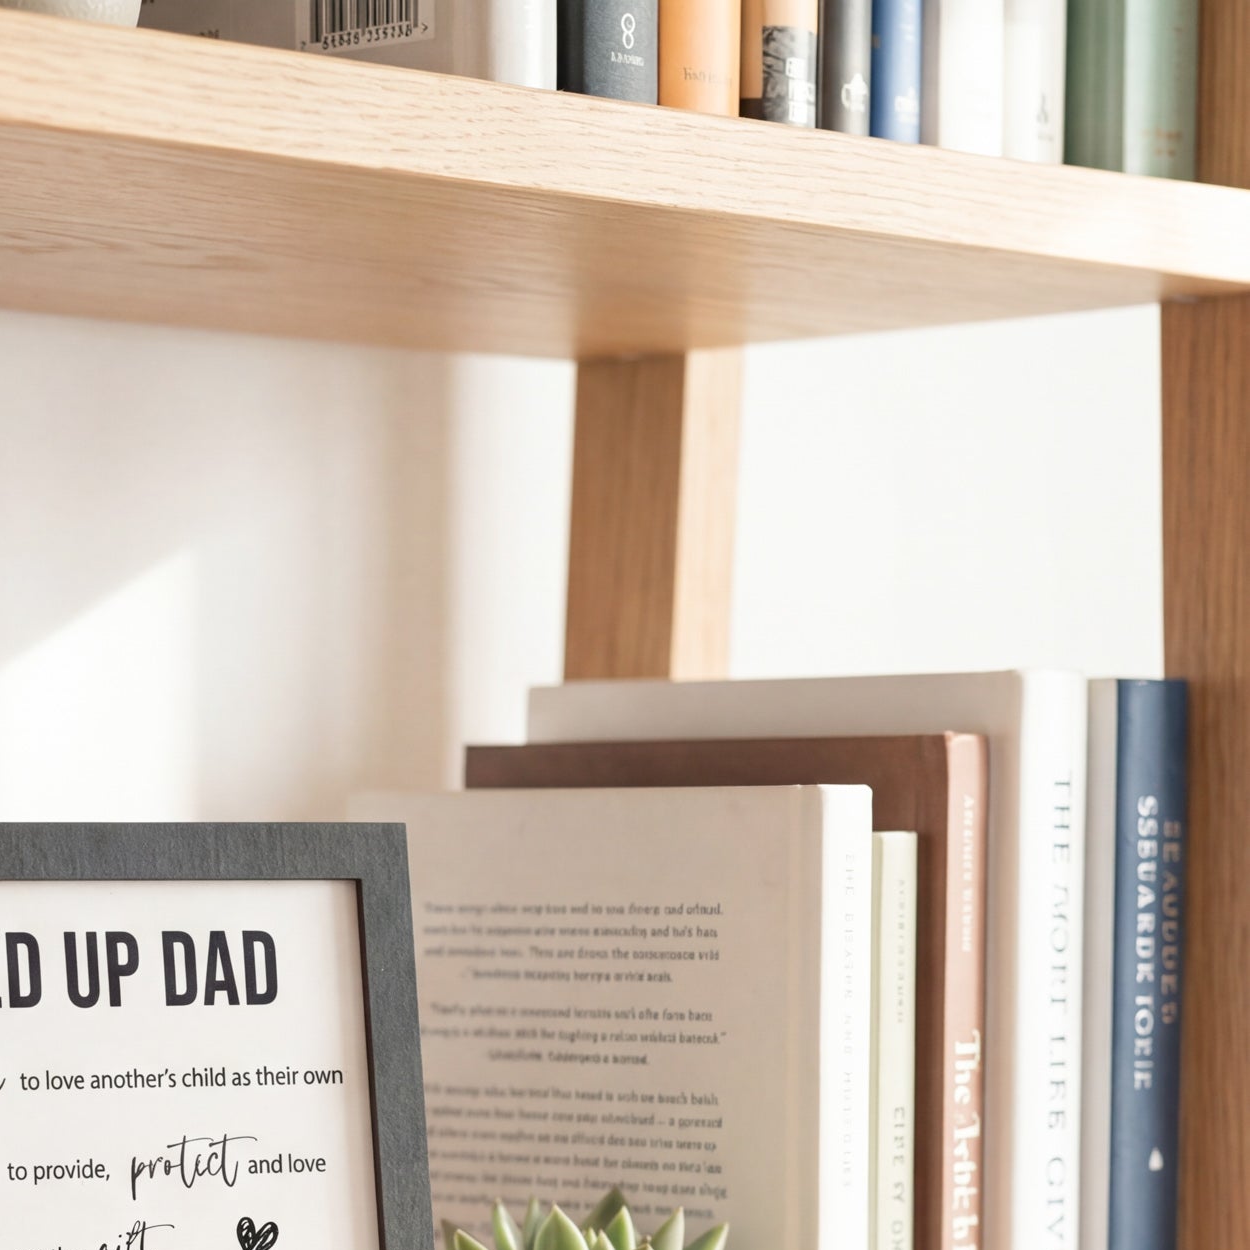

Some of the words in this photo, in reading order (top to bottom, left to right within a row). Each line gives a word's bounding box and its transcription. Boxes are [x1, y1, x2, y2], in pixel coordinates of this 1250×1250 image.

[1051, 770, 1075, 864] THE
[63, 931, 140, 1009] UP
[161, 930, 278, 1007] DAD
[19, 1072, 40, 1091] to
[45, 1069, 85, 1090] love
[181, 1066, 226, 1088] child
[231, 1071, 251, 1087] as
[255, 1065, 299, 1086] their
[303, 1069, 344, 1085] own
[953, 1028, 981, 1105] The
[7, 1163, 28, 1181] to
[33, 1158, 110, 1186] provide,
[130, 1133, 259, 1201] protect
[248, 1153, 283, 1175] and
[288, 1153, 327, 1173] love
